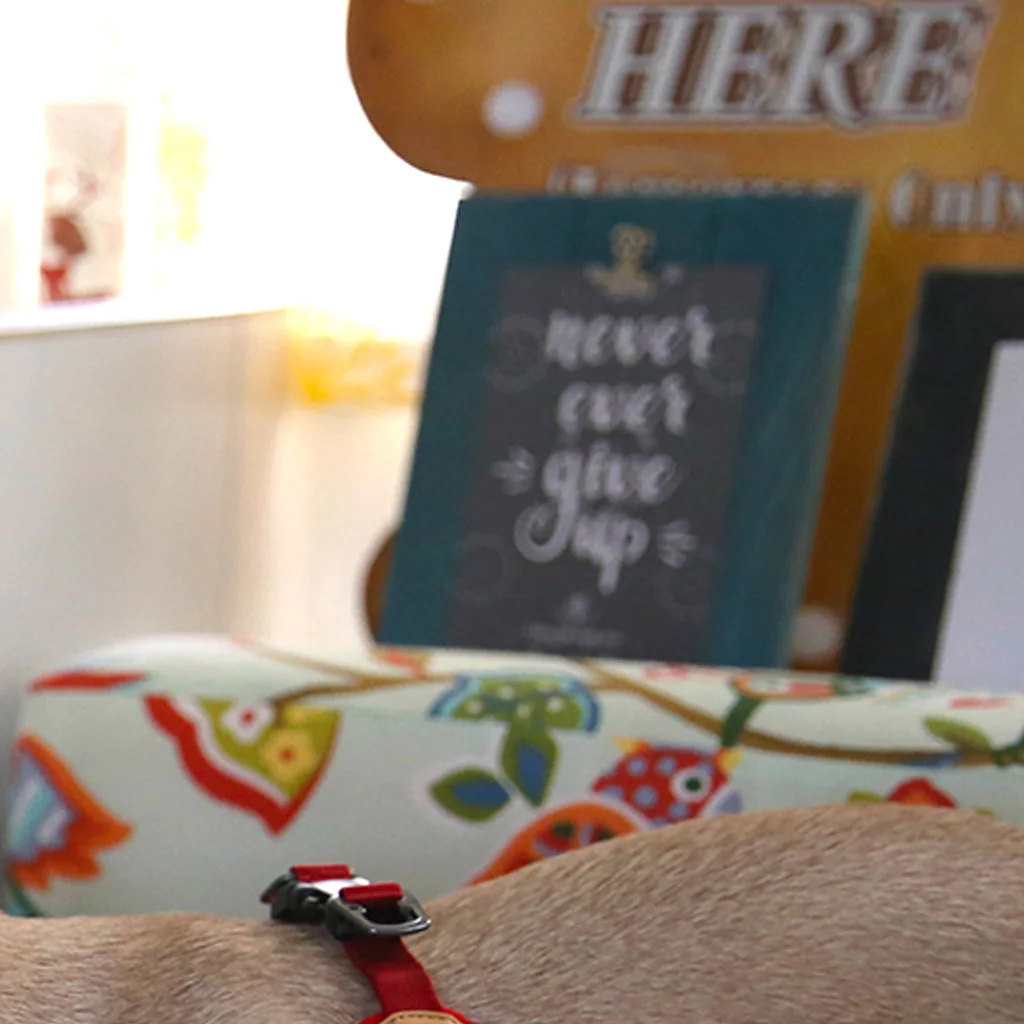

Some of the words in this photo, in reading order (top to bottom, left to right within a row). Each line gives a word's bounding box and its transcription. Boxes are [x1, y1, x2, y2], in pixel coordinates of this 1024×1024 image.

[572, 4, 986, 128] HERE
[546, 306, 715, 370] never
[557, 374, 690, 437] ever
[568, 514, 652, 595] up
